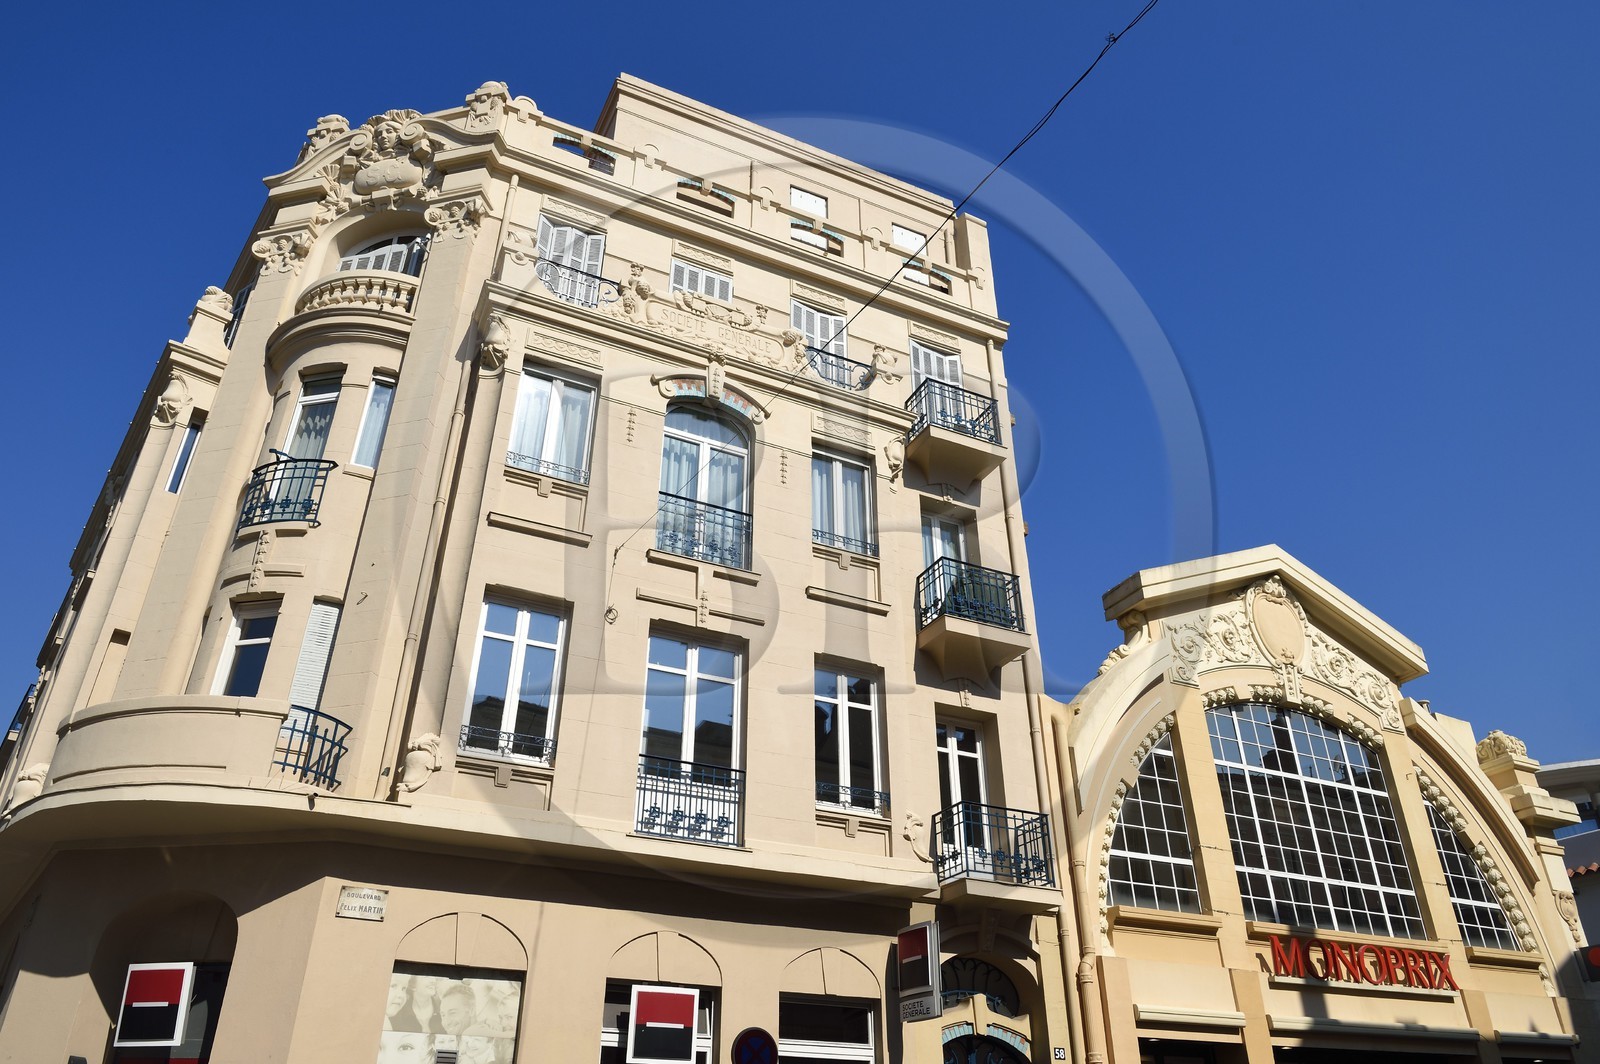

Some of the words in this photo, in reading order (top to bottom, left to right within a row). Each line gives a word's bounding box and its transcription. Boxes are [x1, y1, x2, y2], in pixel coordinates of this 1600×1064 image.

[346, 892, 382, 901] BOULEVARD
[358, 905, 384, 914] MARTIN
[1268, 935, 1460, 991] MONOPRIX
[902, 1006, 931, 1020] GENERALE
[1055, 1048, 1065, 1059] 58
